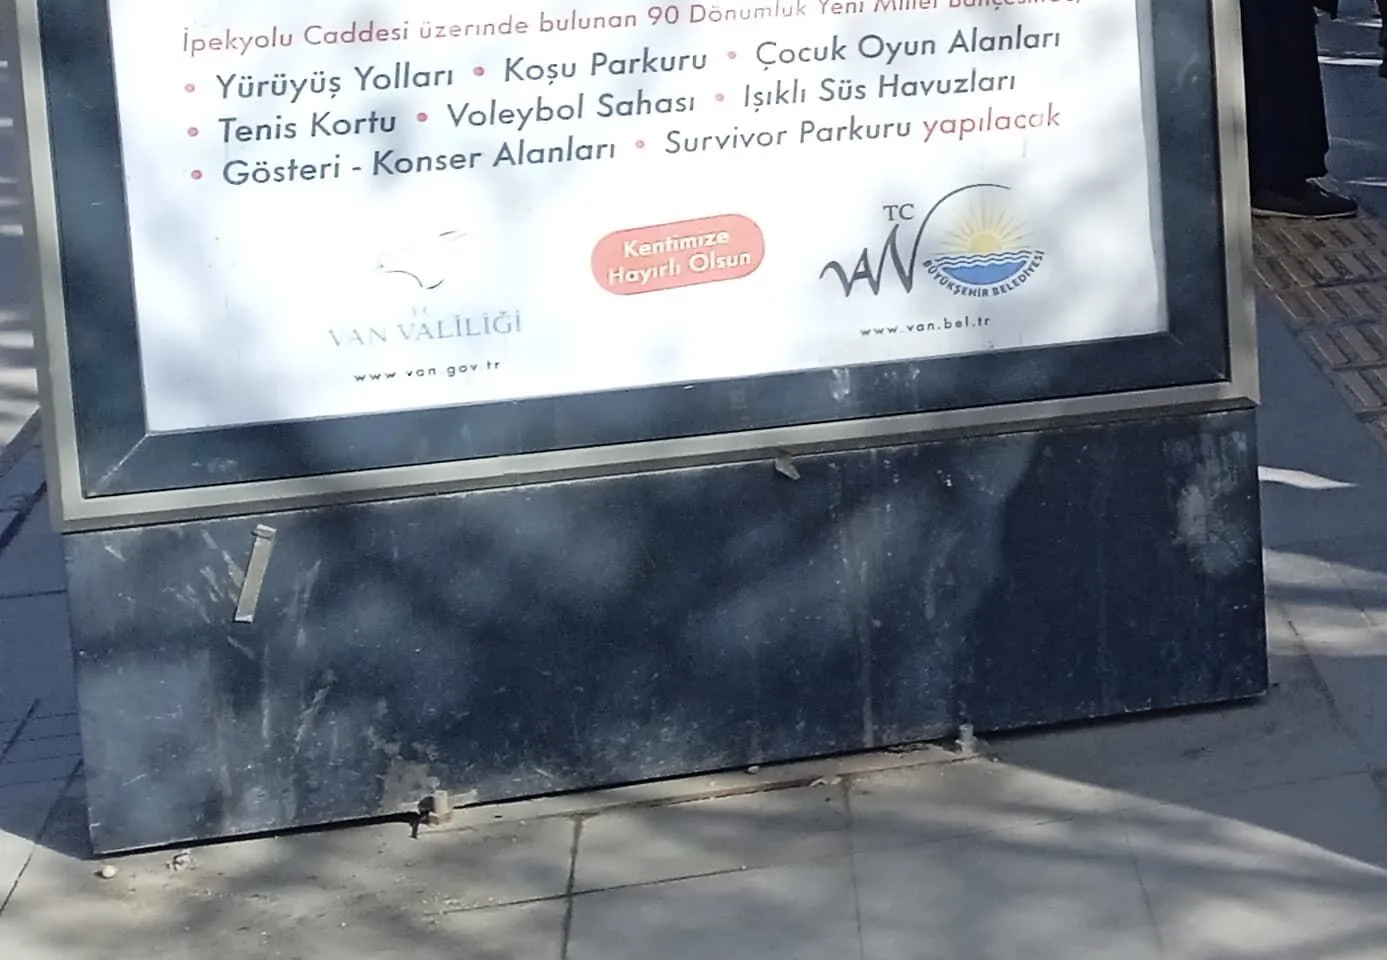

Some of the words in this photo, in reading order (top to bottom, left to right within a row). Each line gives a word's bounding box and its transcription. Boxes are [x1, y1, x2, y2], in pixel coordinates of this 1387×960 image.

[183, 25, 293, 57] İpekyolu
[304, 20, 408, 46] Caddesi
[539, 8, 637, 33] bulunan
[648, 5, 680, 26] 90
[216, 70, 341, 103] Yürüyüş
[354, 61, 453, 91] Yolları
[504, 56, 577, 85] Koşu
[590, 46, 707, 76] Parkuru
[756, 35, 847, 71] Çocuk
[858, 34, 936, 65] Oyun
[947, 24, 1061, 54] Alanları
[218, 115, 297, 143] Tenis
[310, 111, 396, 137] Kortu
[447, 93, 584, 131] Voleybol
[596, 88, 695, 118] Sahası
[744, 78, 806, 112] Işıklı
[819, 78, 866, 101] Süs
[878, 68, 1016, 98] Havuzları
[222, 154, 340, 186] Gösteri
[373, 149, 483, 176] Konser
[492, 135, 615, 167] Alanları
[665, 126, 788, 154] Survivor
[800, 114, 912, 143] Parkuru
[922, 102, 1061, 143] yapılacak
[819, 200, 945, 297] VAN
[883, 203, 915, 221] TC
[688, 251, 752, 273] Olsun
